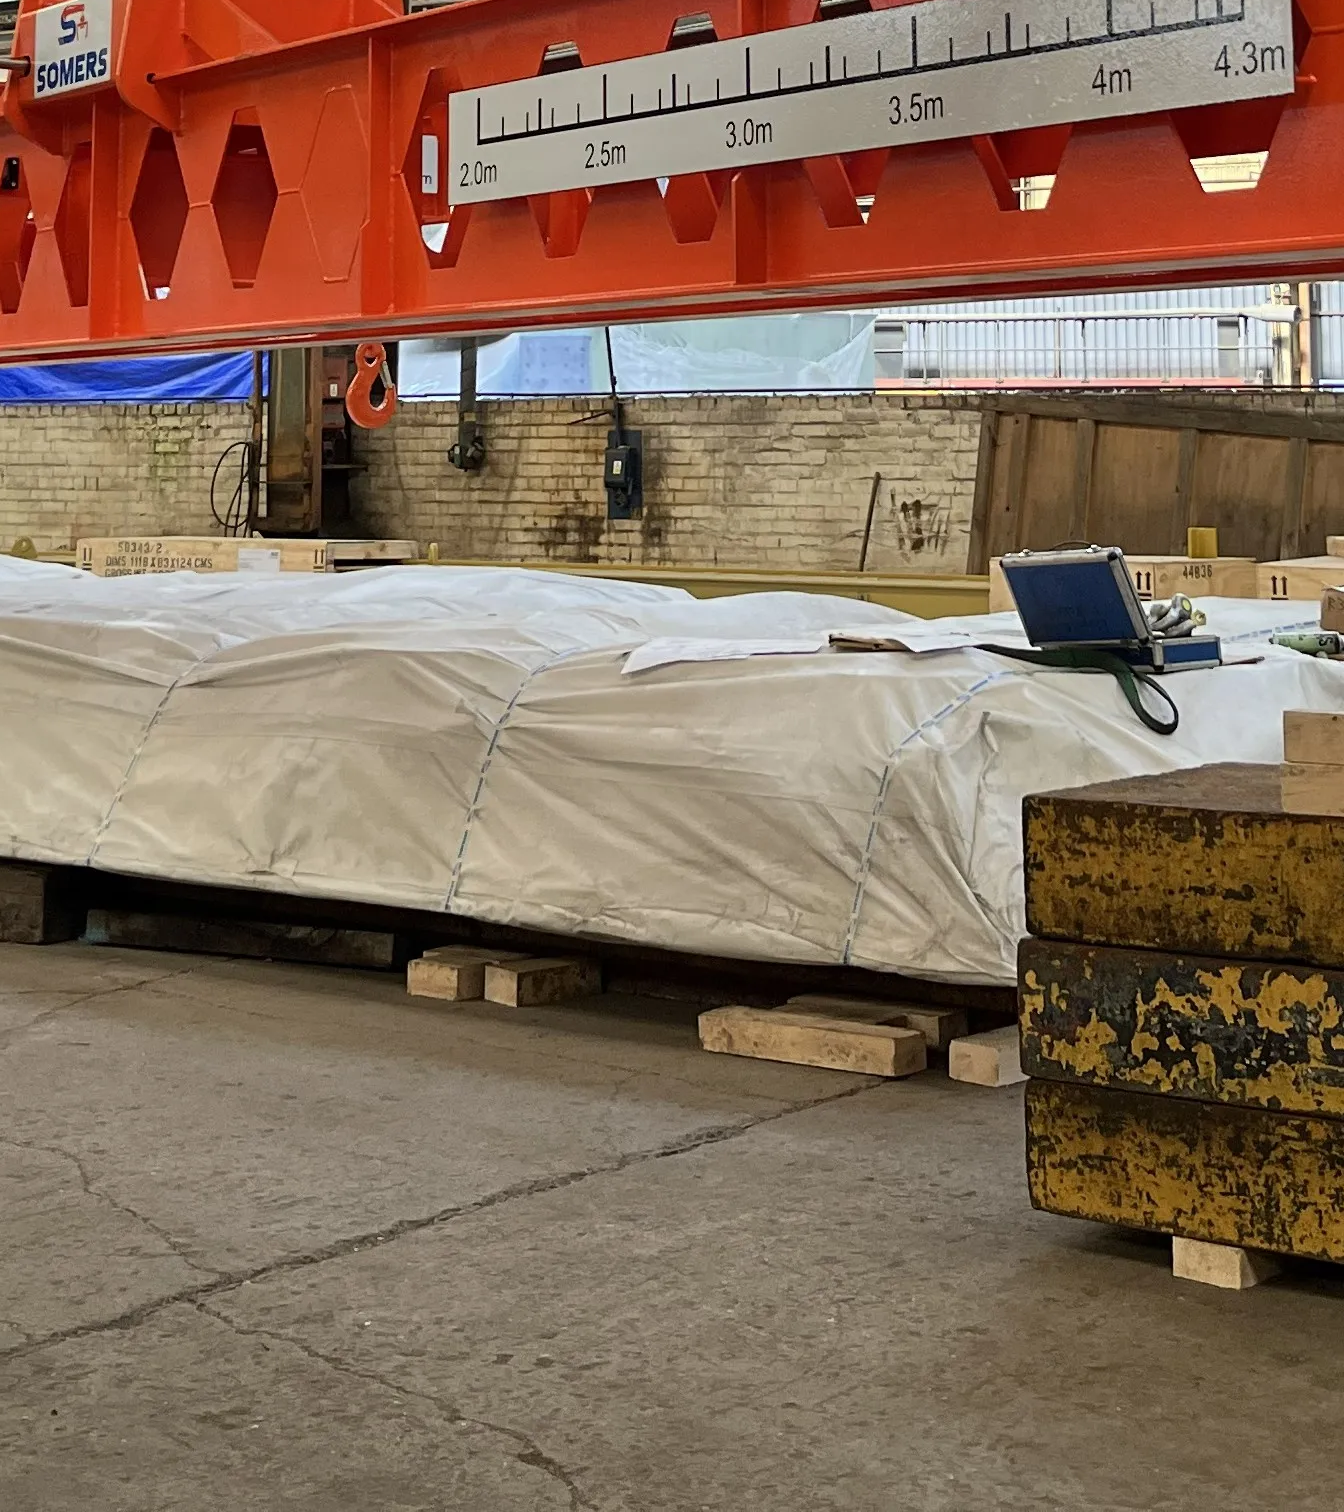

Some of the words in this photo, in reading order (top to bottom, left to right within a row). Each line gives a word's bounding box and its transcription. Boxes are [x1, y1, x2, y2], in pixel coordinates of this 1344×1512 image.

[37, 48, 108, 94] SOMERS
[459, 160, 498, 188] 2.0m
[584, 140, 626, 169] 2.5m
[725, 118, 773, 149] 3.0m
[888, 92, 945, 125] 3.5m
[1091, 63, 1133, 96] 4m
[1214, 41, 1287, 79] 4.3m
[194, 558, 213, 569] CMS
